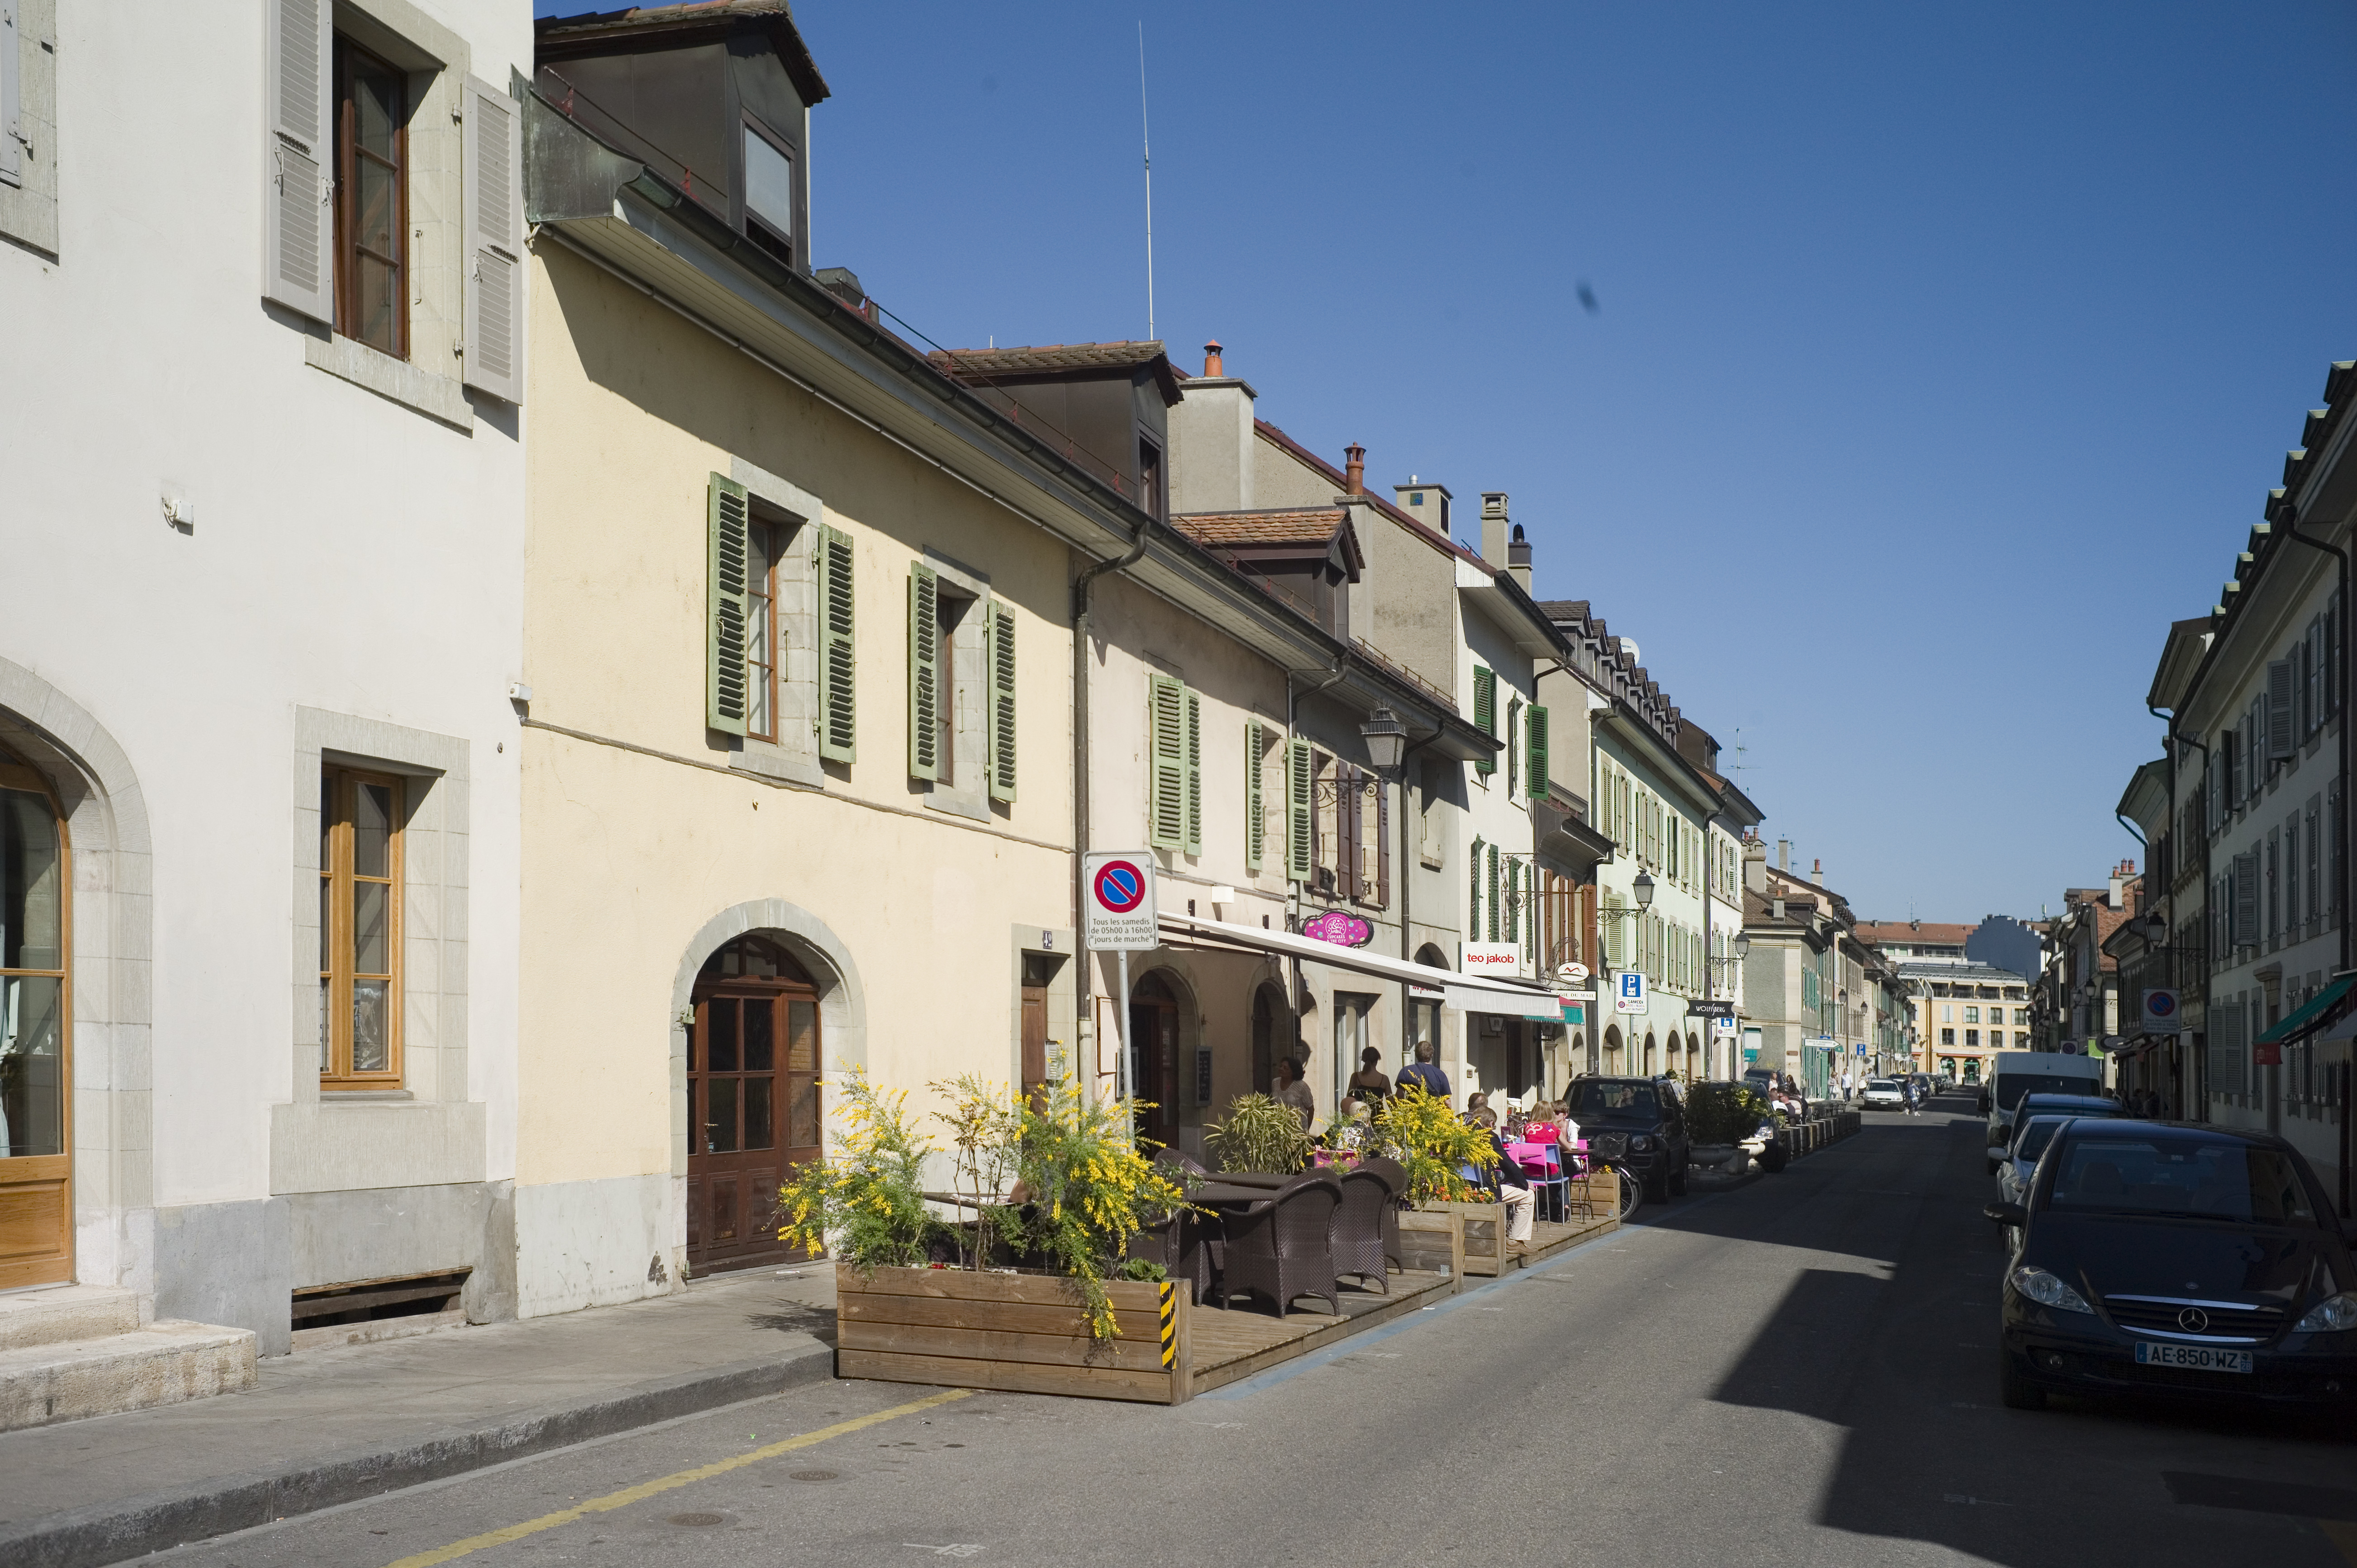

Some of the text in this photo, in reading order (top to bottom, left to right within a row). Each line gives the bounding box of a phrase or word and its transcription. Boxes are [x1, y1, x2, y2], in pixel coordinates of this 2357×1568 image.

[1044, 933, 1052, 947] 42
[1467, 954, 1514, 964] teo jakob
[1628, 976, 1635, 987] P
[1695, 1003, 1725, 1016] WOLFISBERG
[2241, 1362, 2251, 1370] 2B
